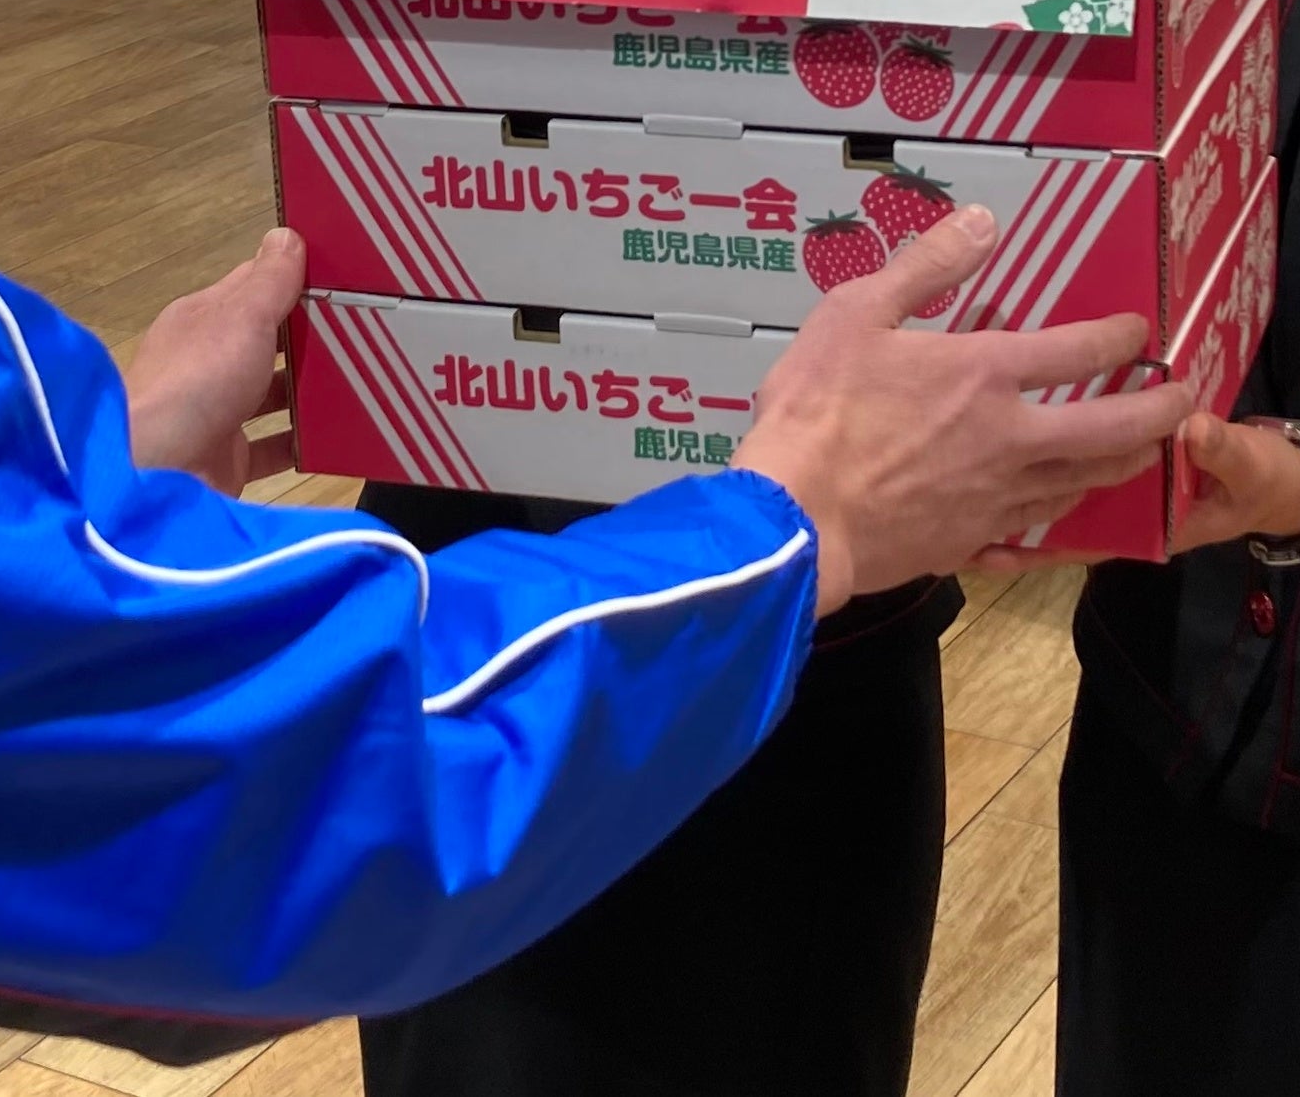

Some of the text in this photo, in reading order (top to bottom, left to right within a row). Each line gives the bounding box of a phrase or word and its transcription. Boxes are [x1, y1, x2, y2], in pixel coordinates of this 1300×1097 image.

[613, 32, 791, 75] 鹿児島県産
[422, 155, 798, 233] 北山いちご一会
[622, 228, 798, 273] 鹿児島県産
[433, 354, 757, 423] 北山いちご一
[634, 426, 744, 465] 鹿児島
